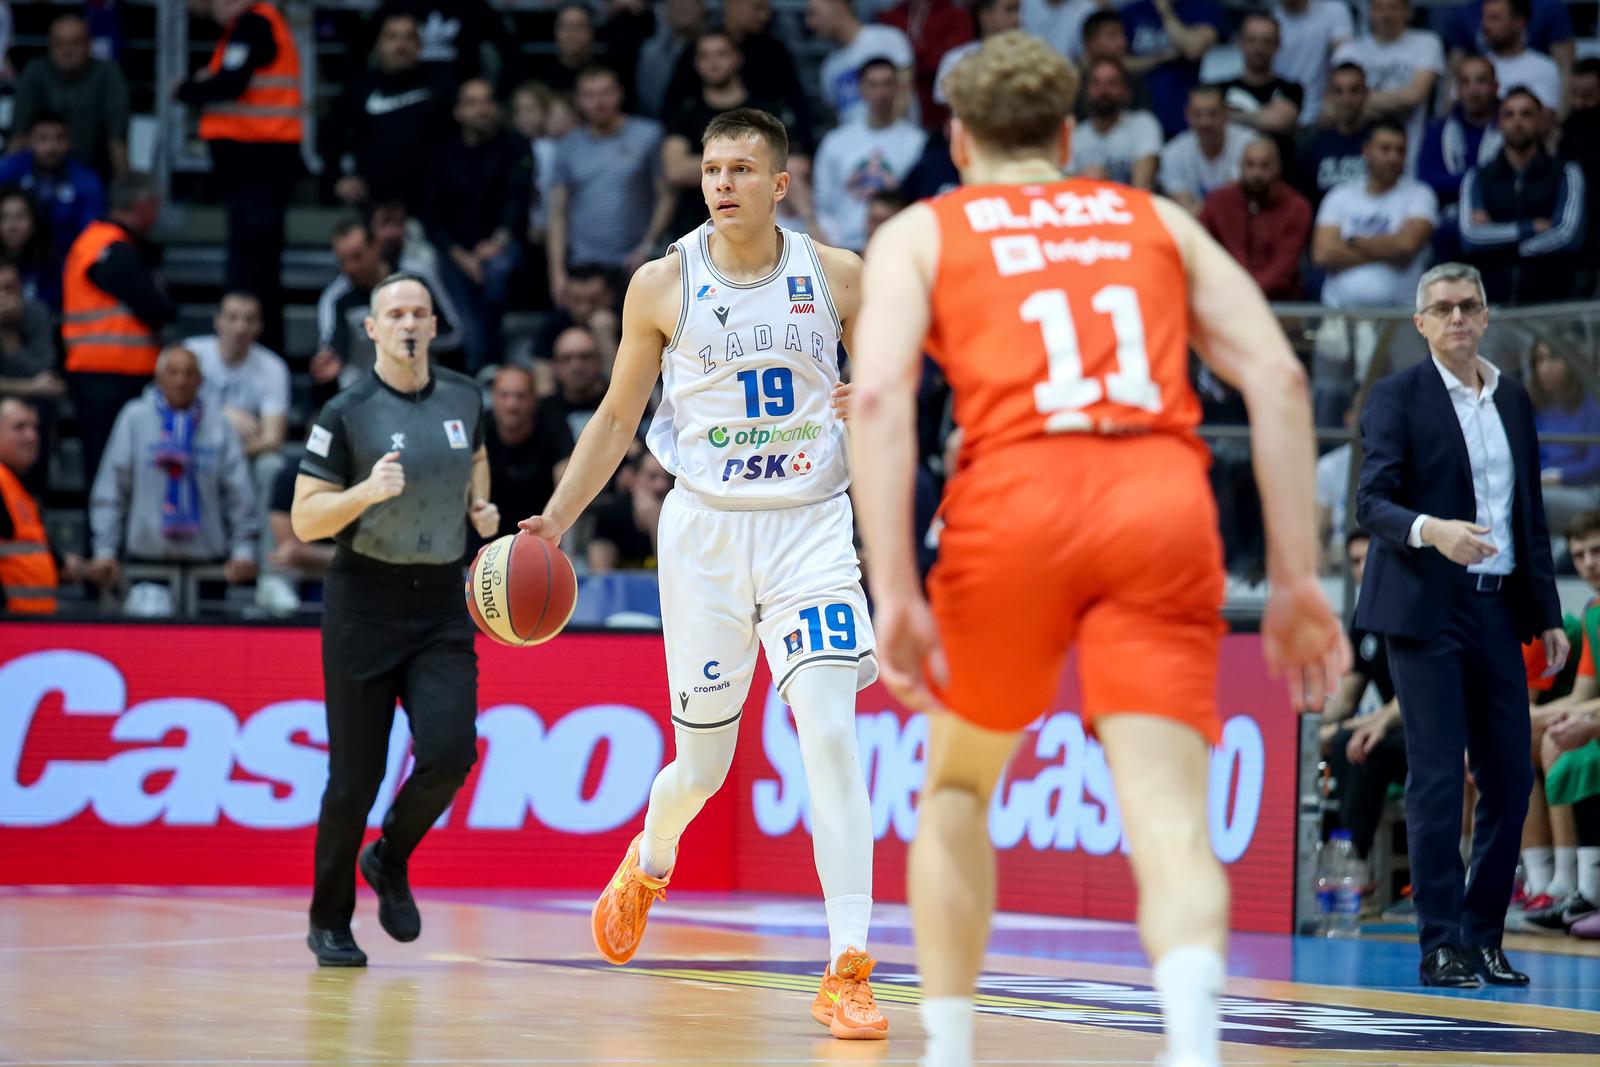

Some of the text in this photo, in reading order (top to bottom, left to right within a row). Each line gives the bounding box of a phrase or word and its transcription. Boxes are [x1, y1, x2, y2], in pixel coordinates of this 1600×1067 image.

[790, 303, 815, 314] AVIA
[699, 324, 824, 374] ZADAR
[1019, 285, 1163, 414] 11
[737, 367, 795, 418] 19
[722, 454, 789, 481] PSK
[798, 603, 857, 652] 19
[694, 681, 731, 693] cromaris
